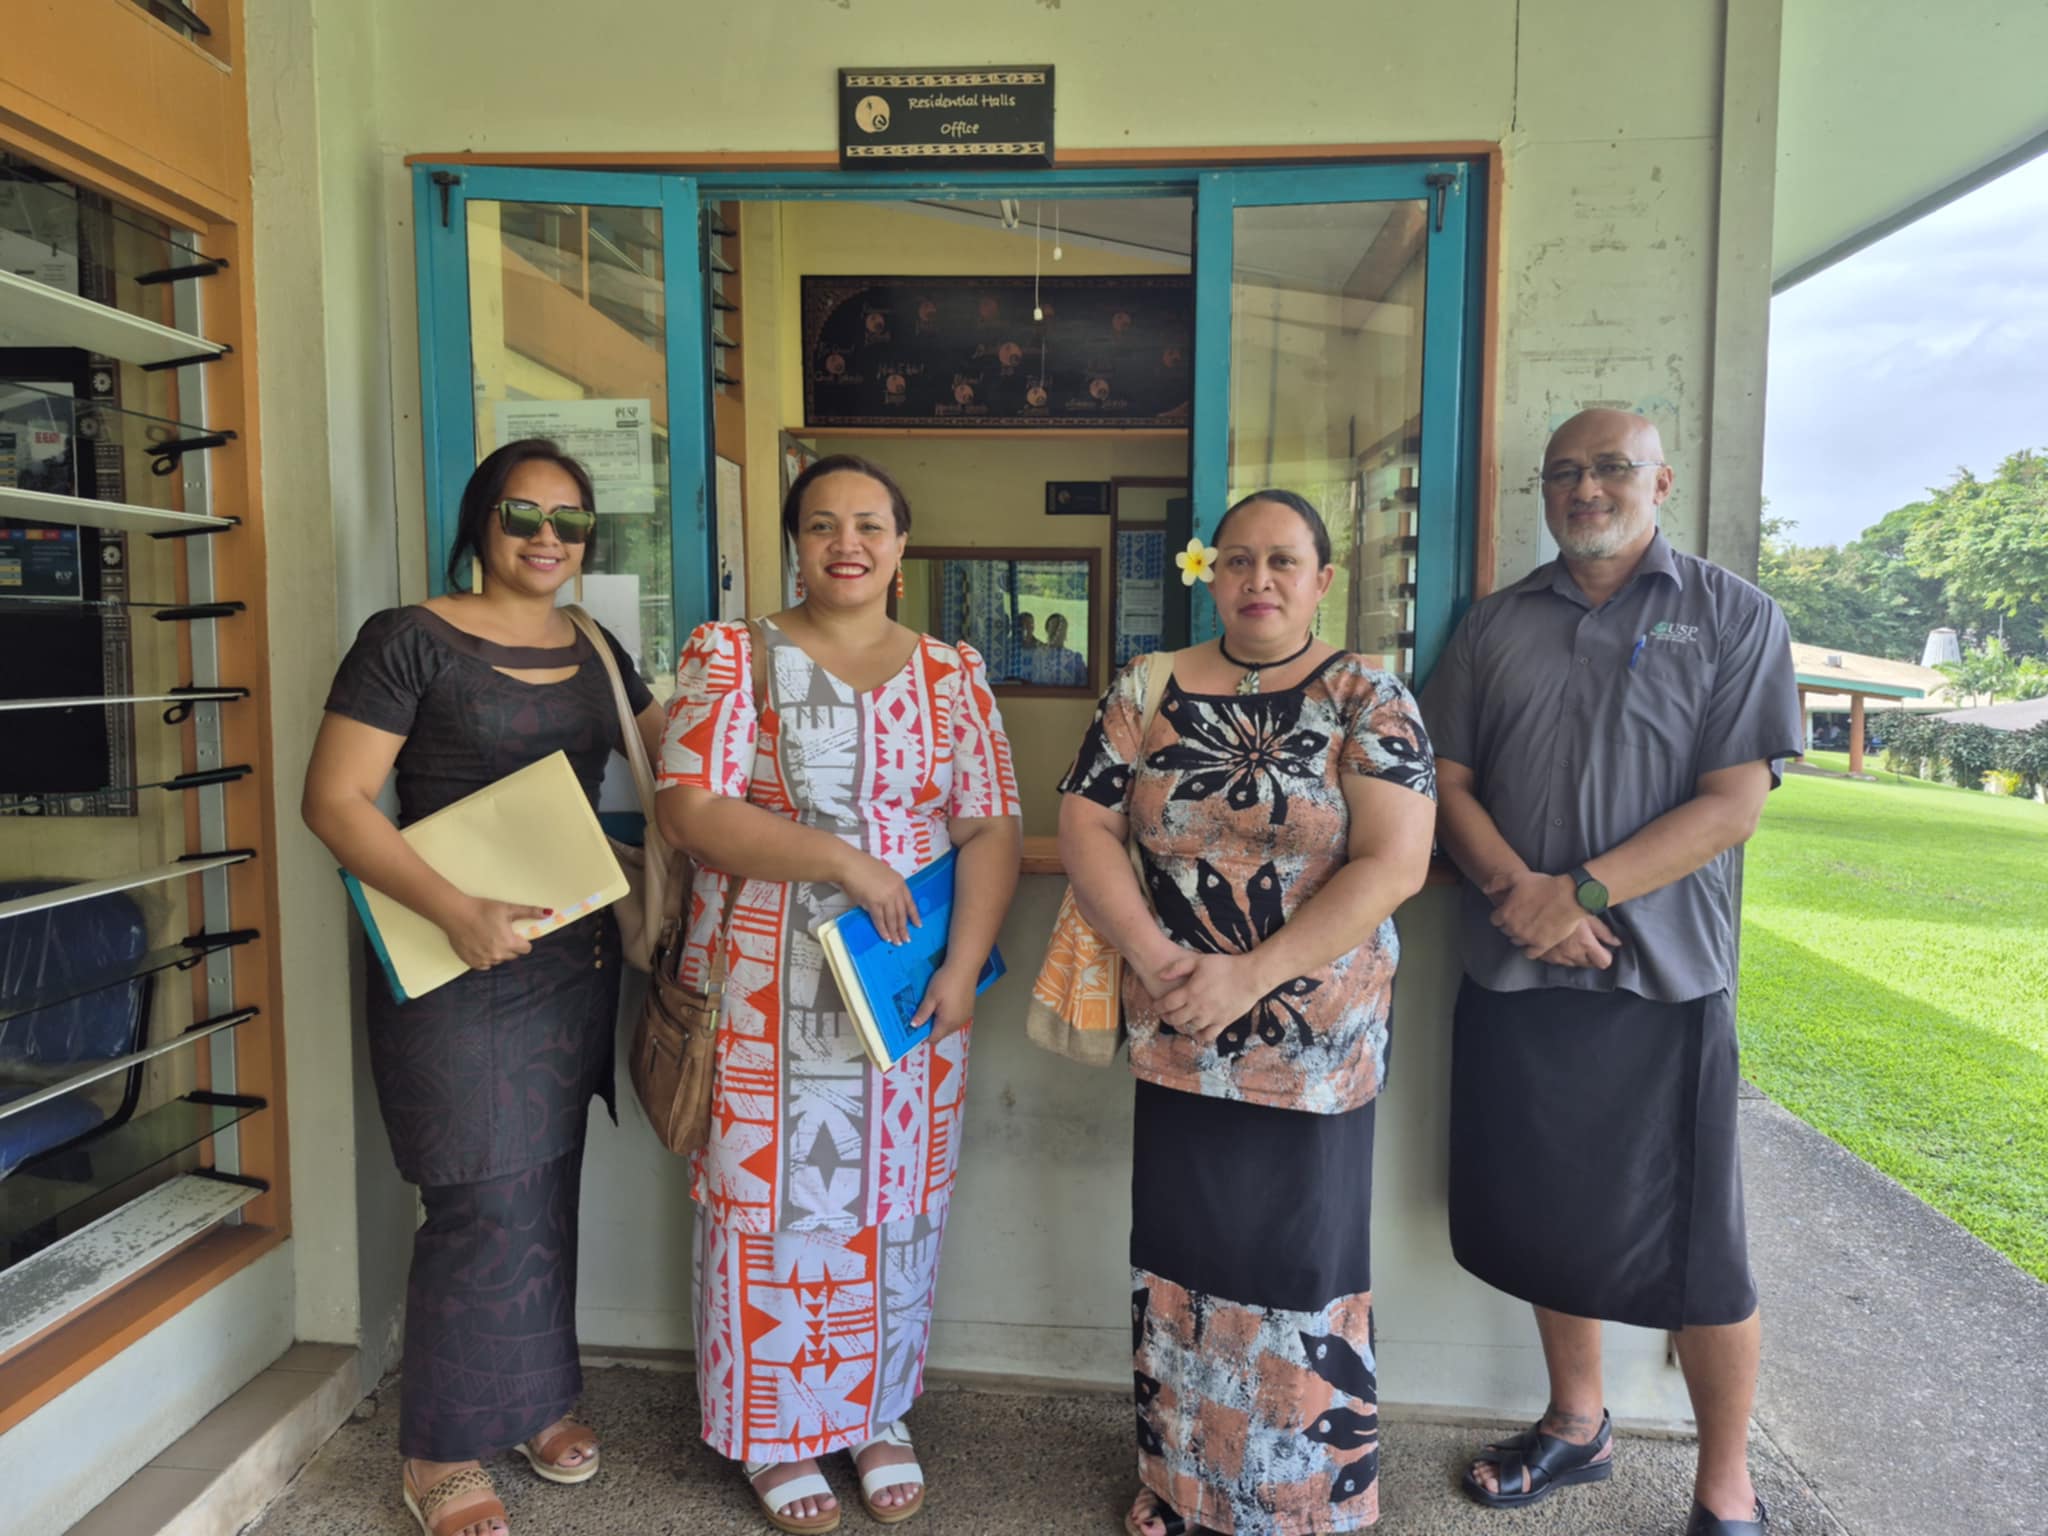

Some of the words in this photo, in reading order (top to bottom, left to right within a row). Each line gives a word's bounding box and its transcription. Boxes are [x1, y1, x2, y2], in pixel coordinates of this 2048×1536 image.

[908, 93, 978, 110] Residential
[982, 93, 1016, 107] Halls
[940, 121, 980, 138] Office
[1668, 623, 1699, 637] USP
